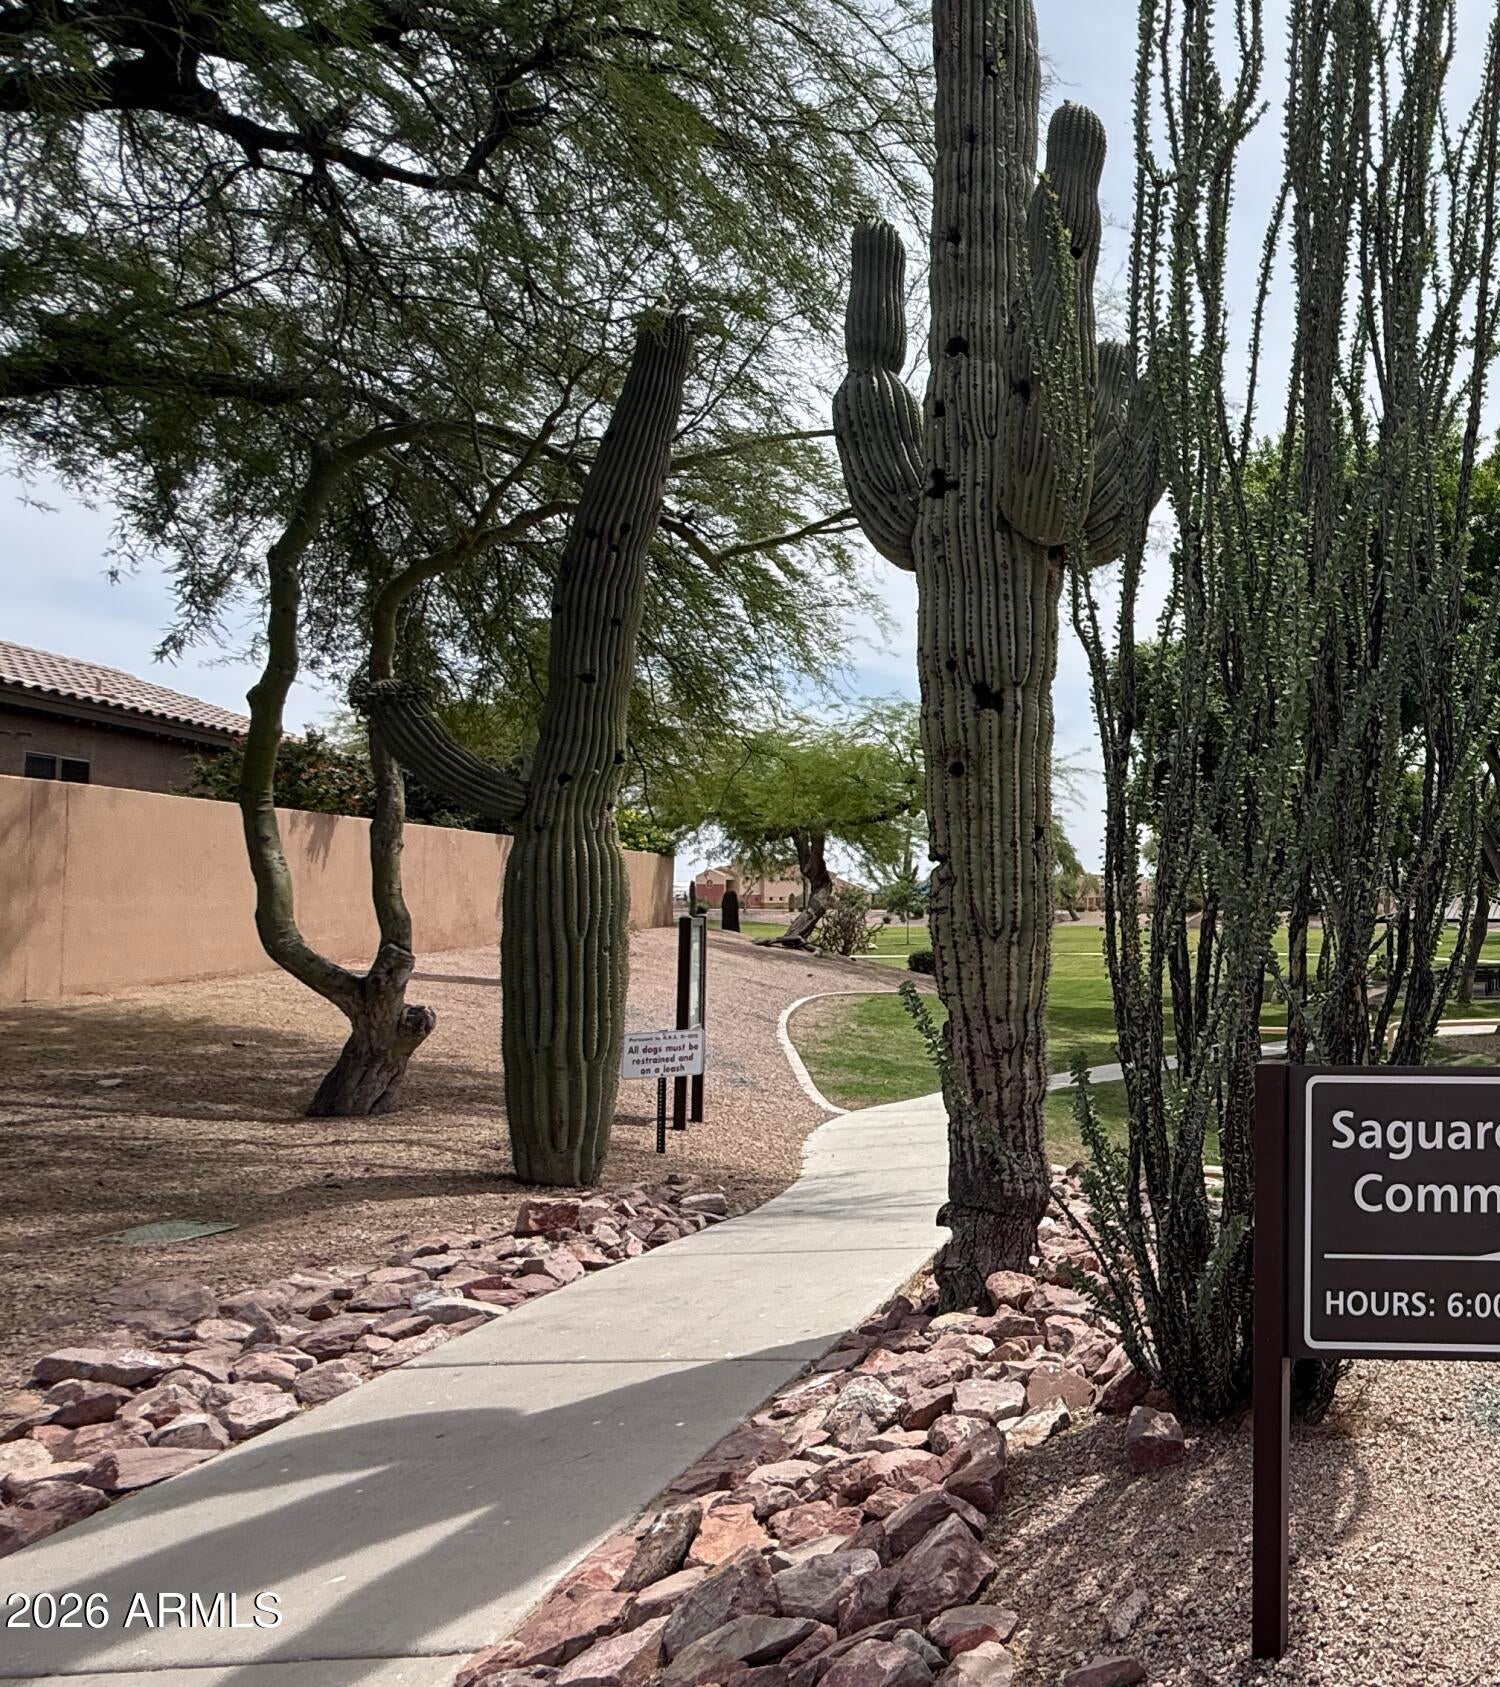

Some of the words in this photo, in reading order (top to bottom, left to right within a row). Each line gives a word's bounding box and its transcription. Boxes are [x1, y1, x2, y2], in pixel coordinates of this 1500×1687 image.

[628, 1046, 639, 1054] All
[642, 1045, 662, 1055] dogs
[665, 1044, 685, 1052] must
[632, 1054, 675, 1065] restrained
[679, 1053, 694, 1062] and
[663, 1064, 685, 1073] leash
[1325, 1290, 1435, 1317] HOURS:
